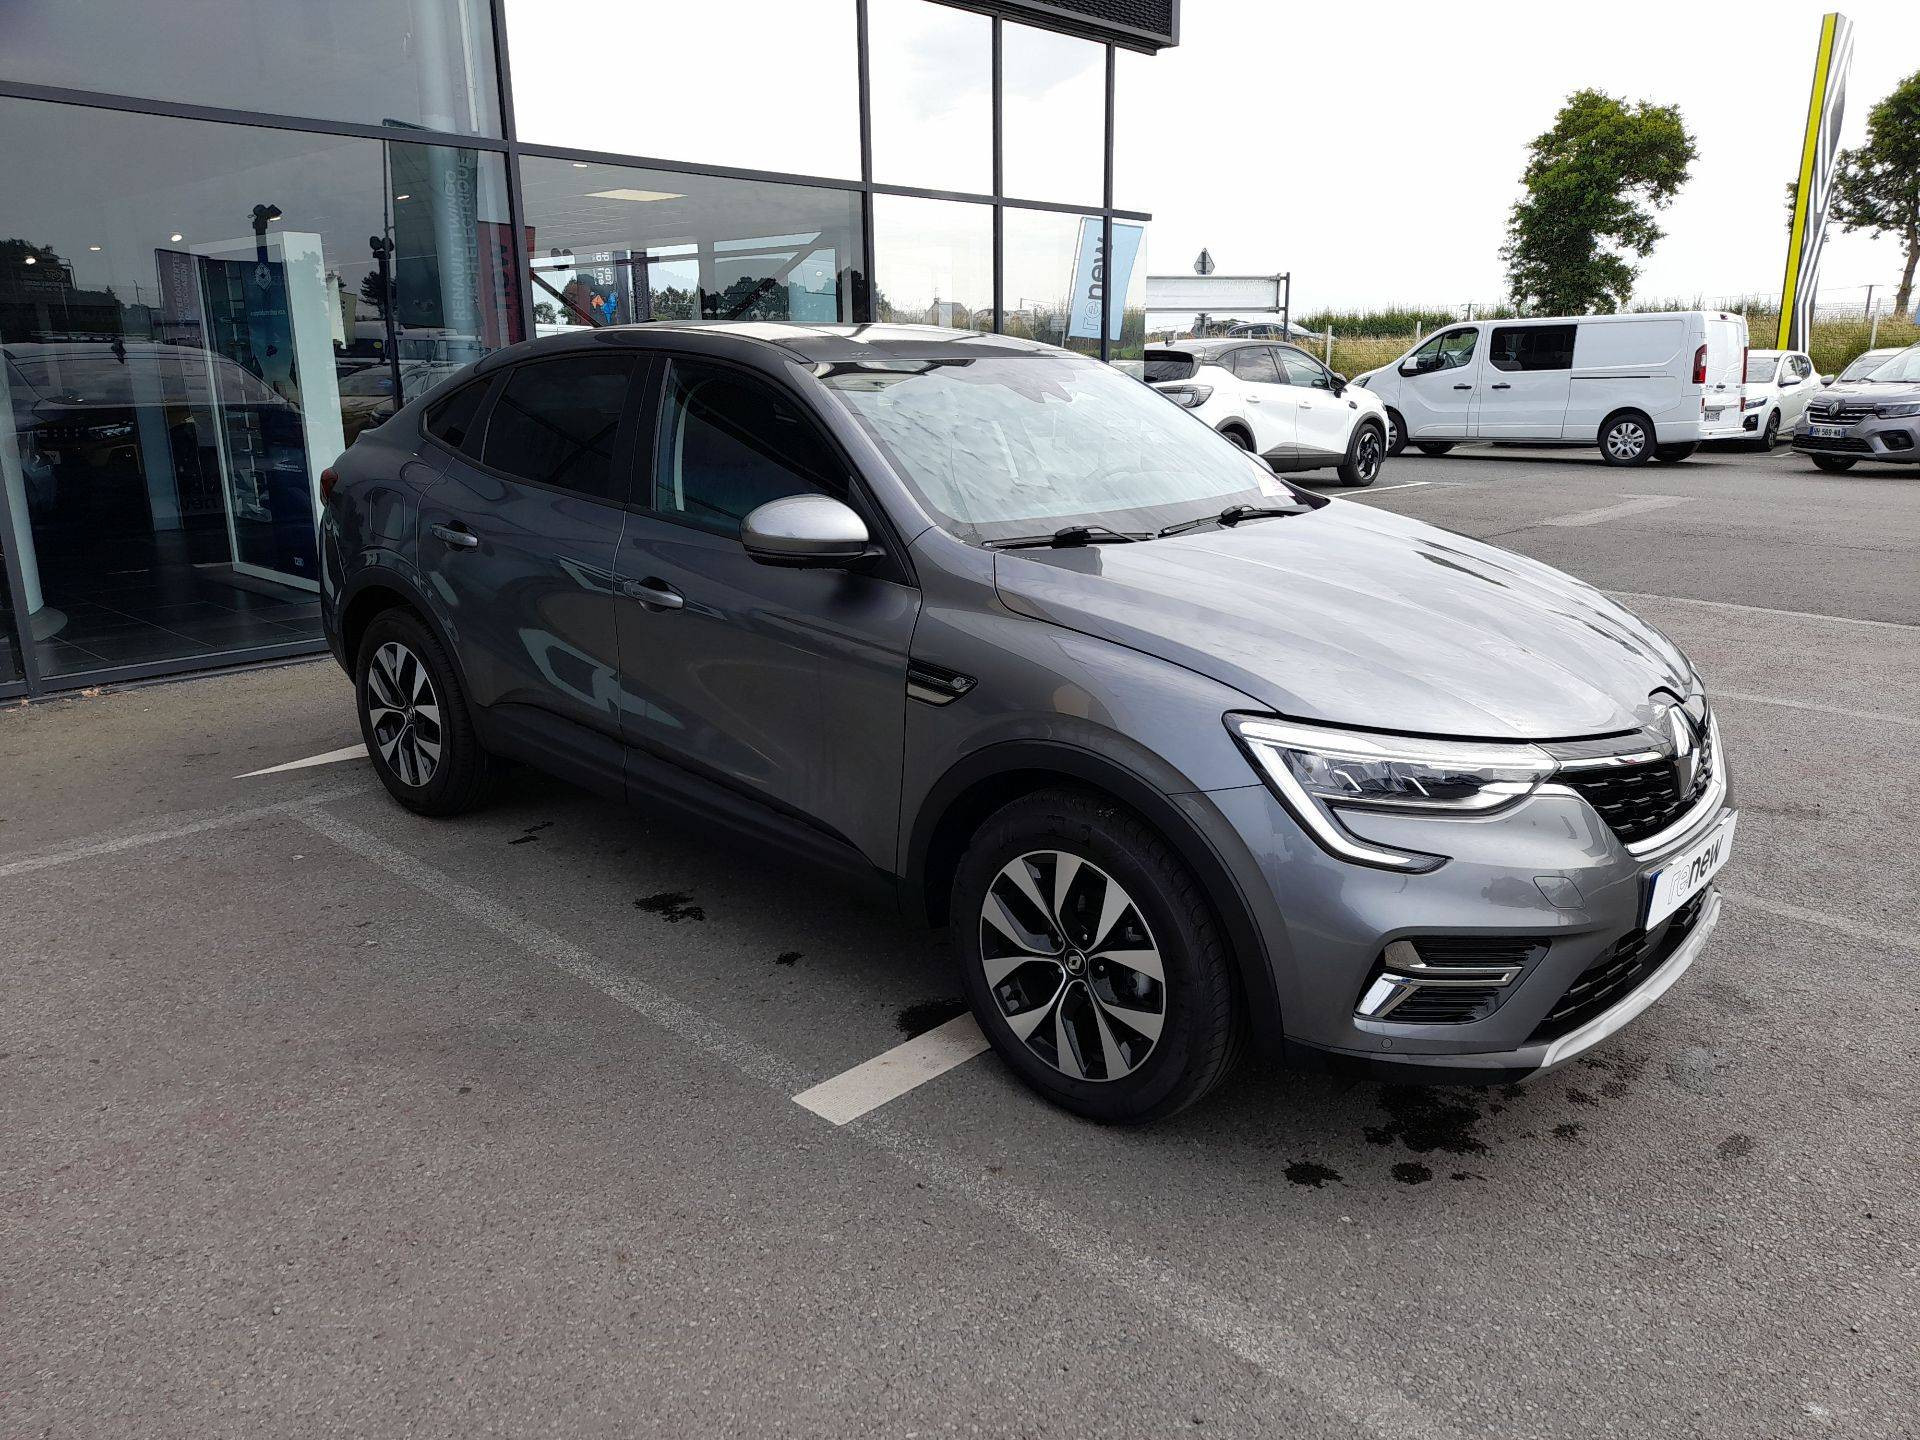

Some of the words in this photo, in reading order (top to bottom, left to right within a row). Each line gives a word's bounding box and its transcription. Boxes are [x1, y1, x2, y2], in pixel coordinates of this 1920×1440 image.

[445, 170, 462, 240] TWINGO
[452, 247, 466, 320] RENAULT
[1667, 834, 1724, 905] renew
